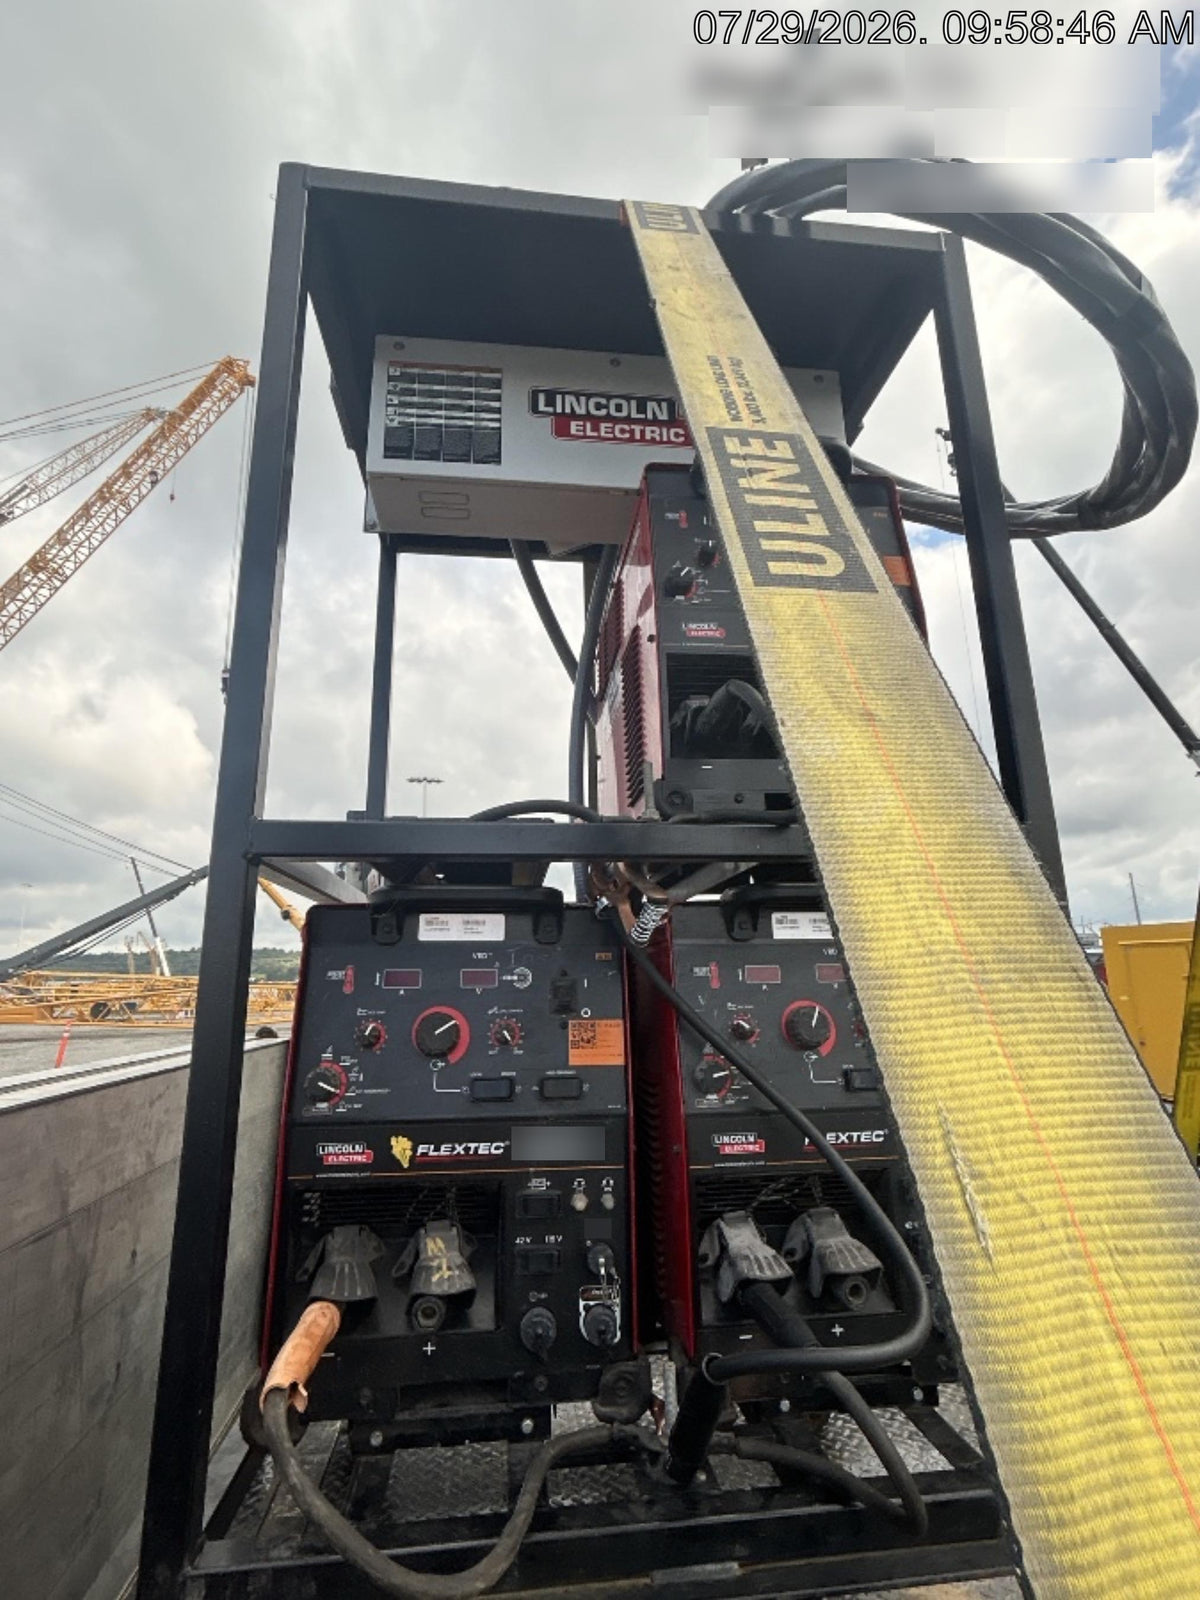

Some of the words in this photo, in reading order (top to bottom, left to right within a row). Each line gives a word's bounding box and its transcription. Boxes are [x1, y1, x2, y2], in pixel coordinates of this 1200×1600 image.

[538, 392, 669, 420] LINCOLN
[570, 421, 685, 442] ELECTRIC
[723, 436, 845, 577] ULINE
[714, 1135, 755, 1144] LINCOLN
[804, 1130, 885, 1145] EXTEC
[319, 1144, 363, 1154] LINCOLN
[416, 1142, 505, 1156] FLEXTEC
[328, 1154, 367, 1162] ELECTRIC
